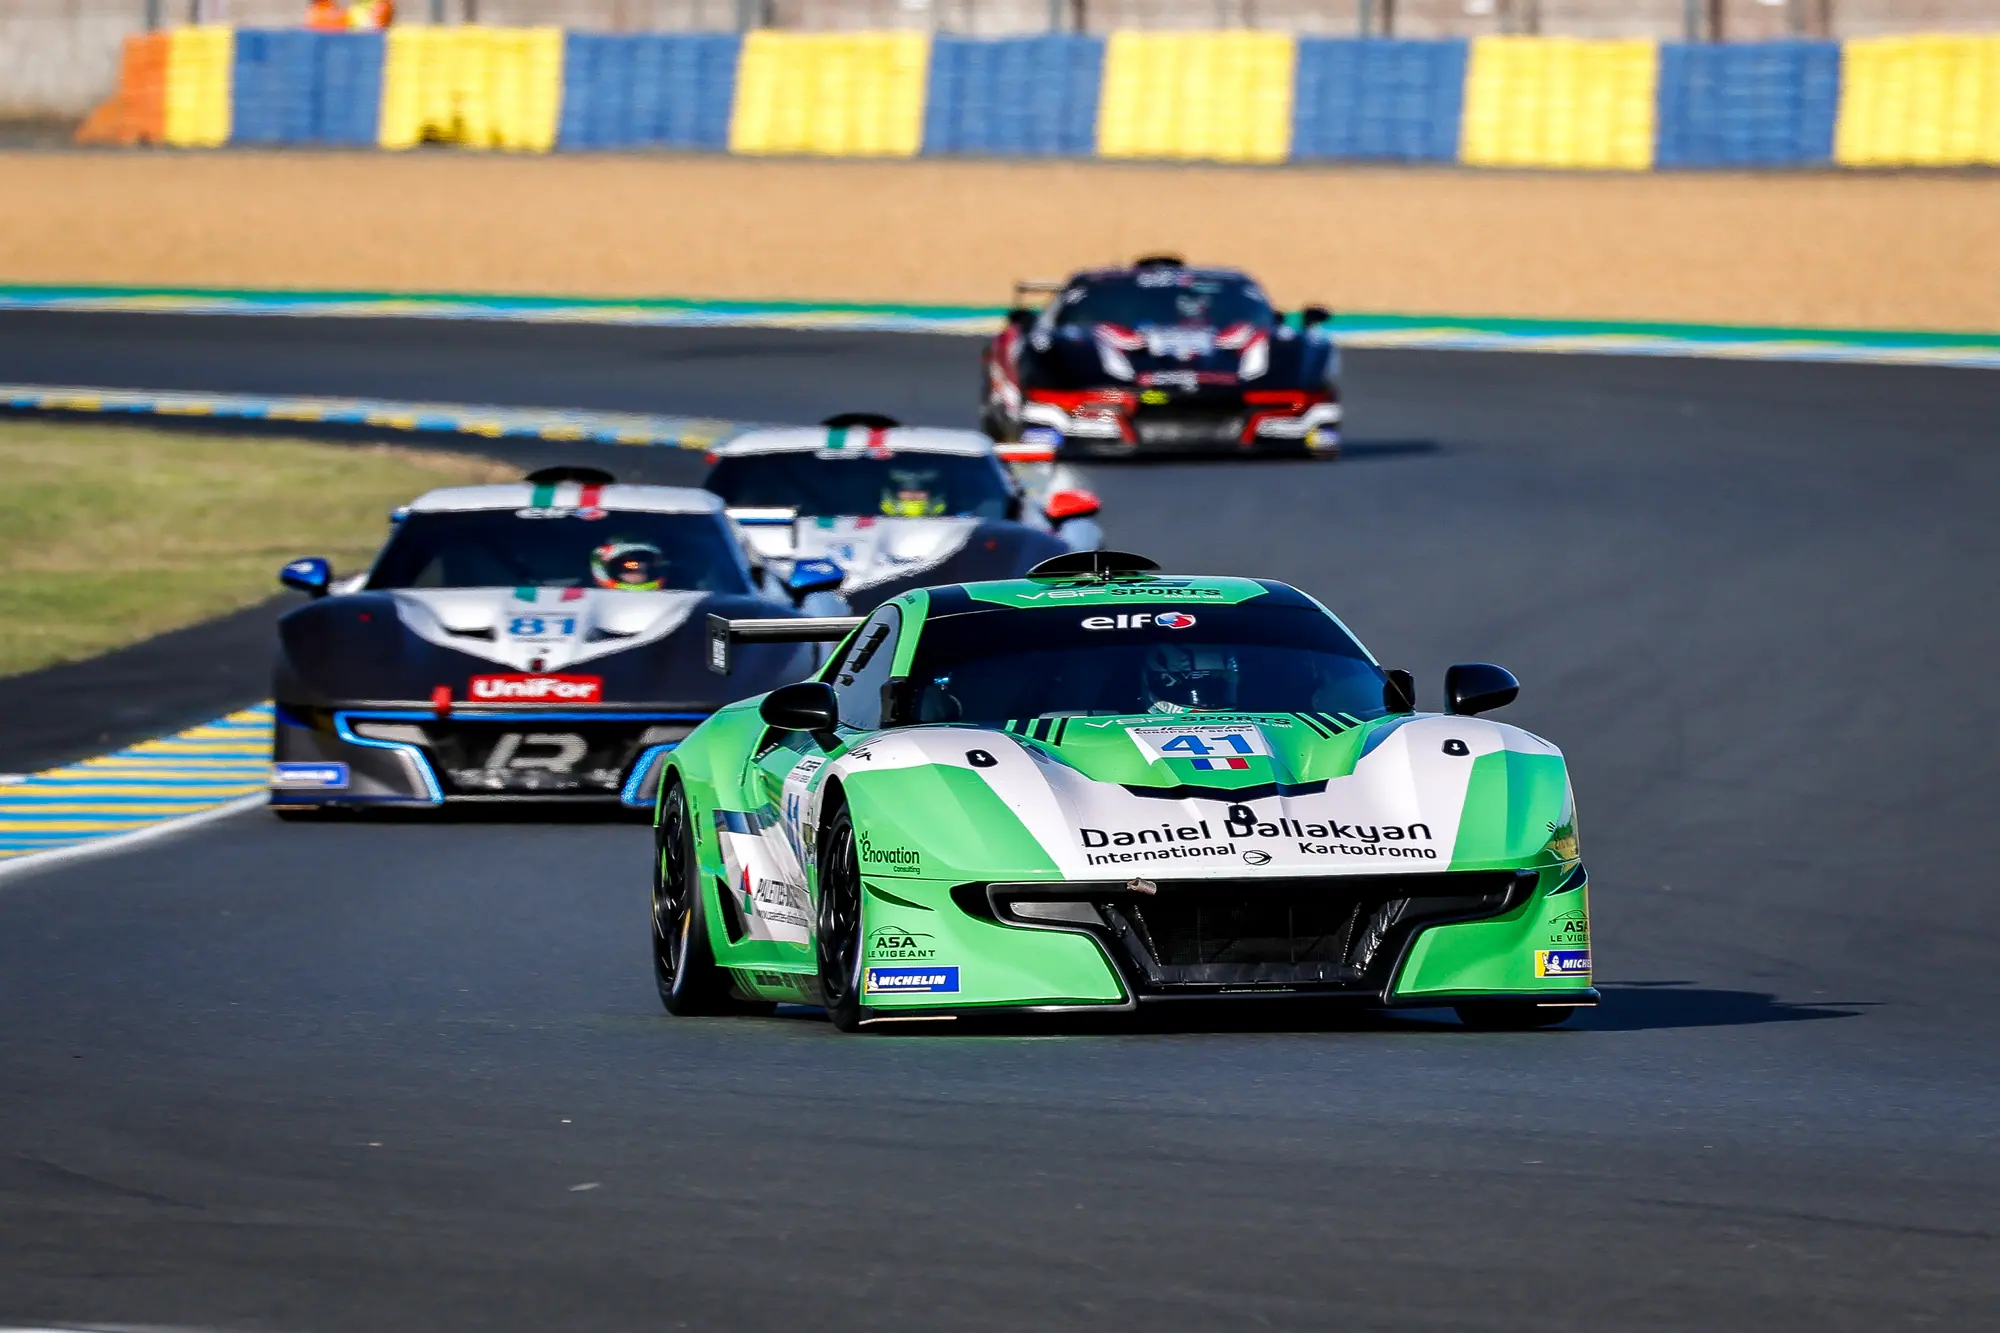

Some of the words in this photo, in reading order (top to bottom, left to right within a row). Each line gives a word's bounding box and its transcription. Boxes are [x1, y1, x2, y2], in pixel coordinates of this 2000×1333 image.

[1111, 588, 1221, 596] SPORTS
[508, 616, 576, 636] 81
[1081, 613, 1152, 629] elf
[471, 677, 598, 698] UniFor
[1180, 715, 1291, 725] SPORTS
[1161, 734, 1255, 755] 41
[1079, 819, 1212, 848] Daniel
[1223, 817, 1433, 843] Dallakyan
[1086, 842, 1237, 866] International
[1299, 842, 1437, 859] Kartodromo
[893, 865, 920, 875] Consulting
[876, 936, 917, 948] ASA
[1550, 934, 1563, 942] LE
[1566, 934, 1588, 942] VIGE
[868, 950, 876, 958] LE
[878, 950, 936, 958] VIGEANT
[1562, 958, 1592, 969] MICHE
[878, 974, 947, 986] MICHELIN
